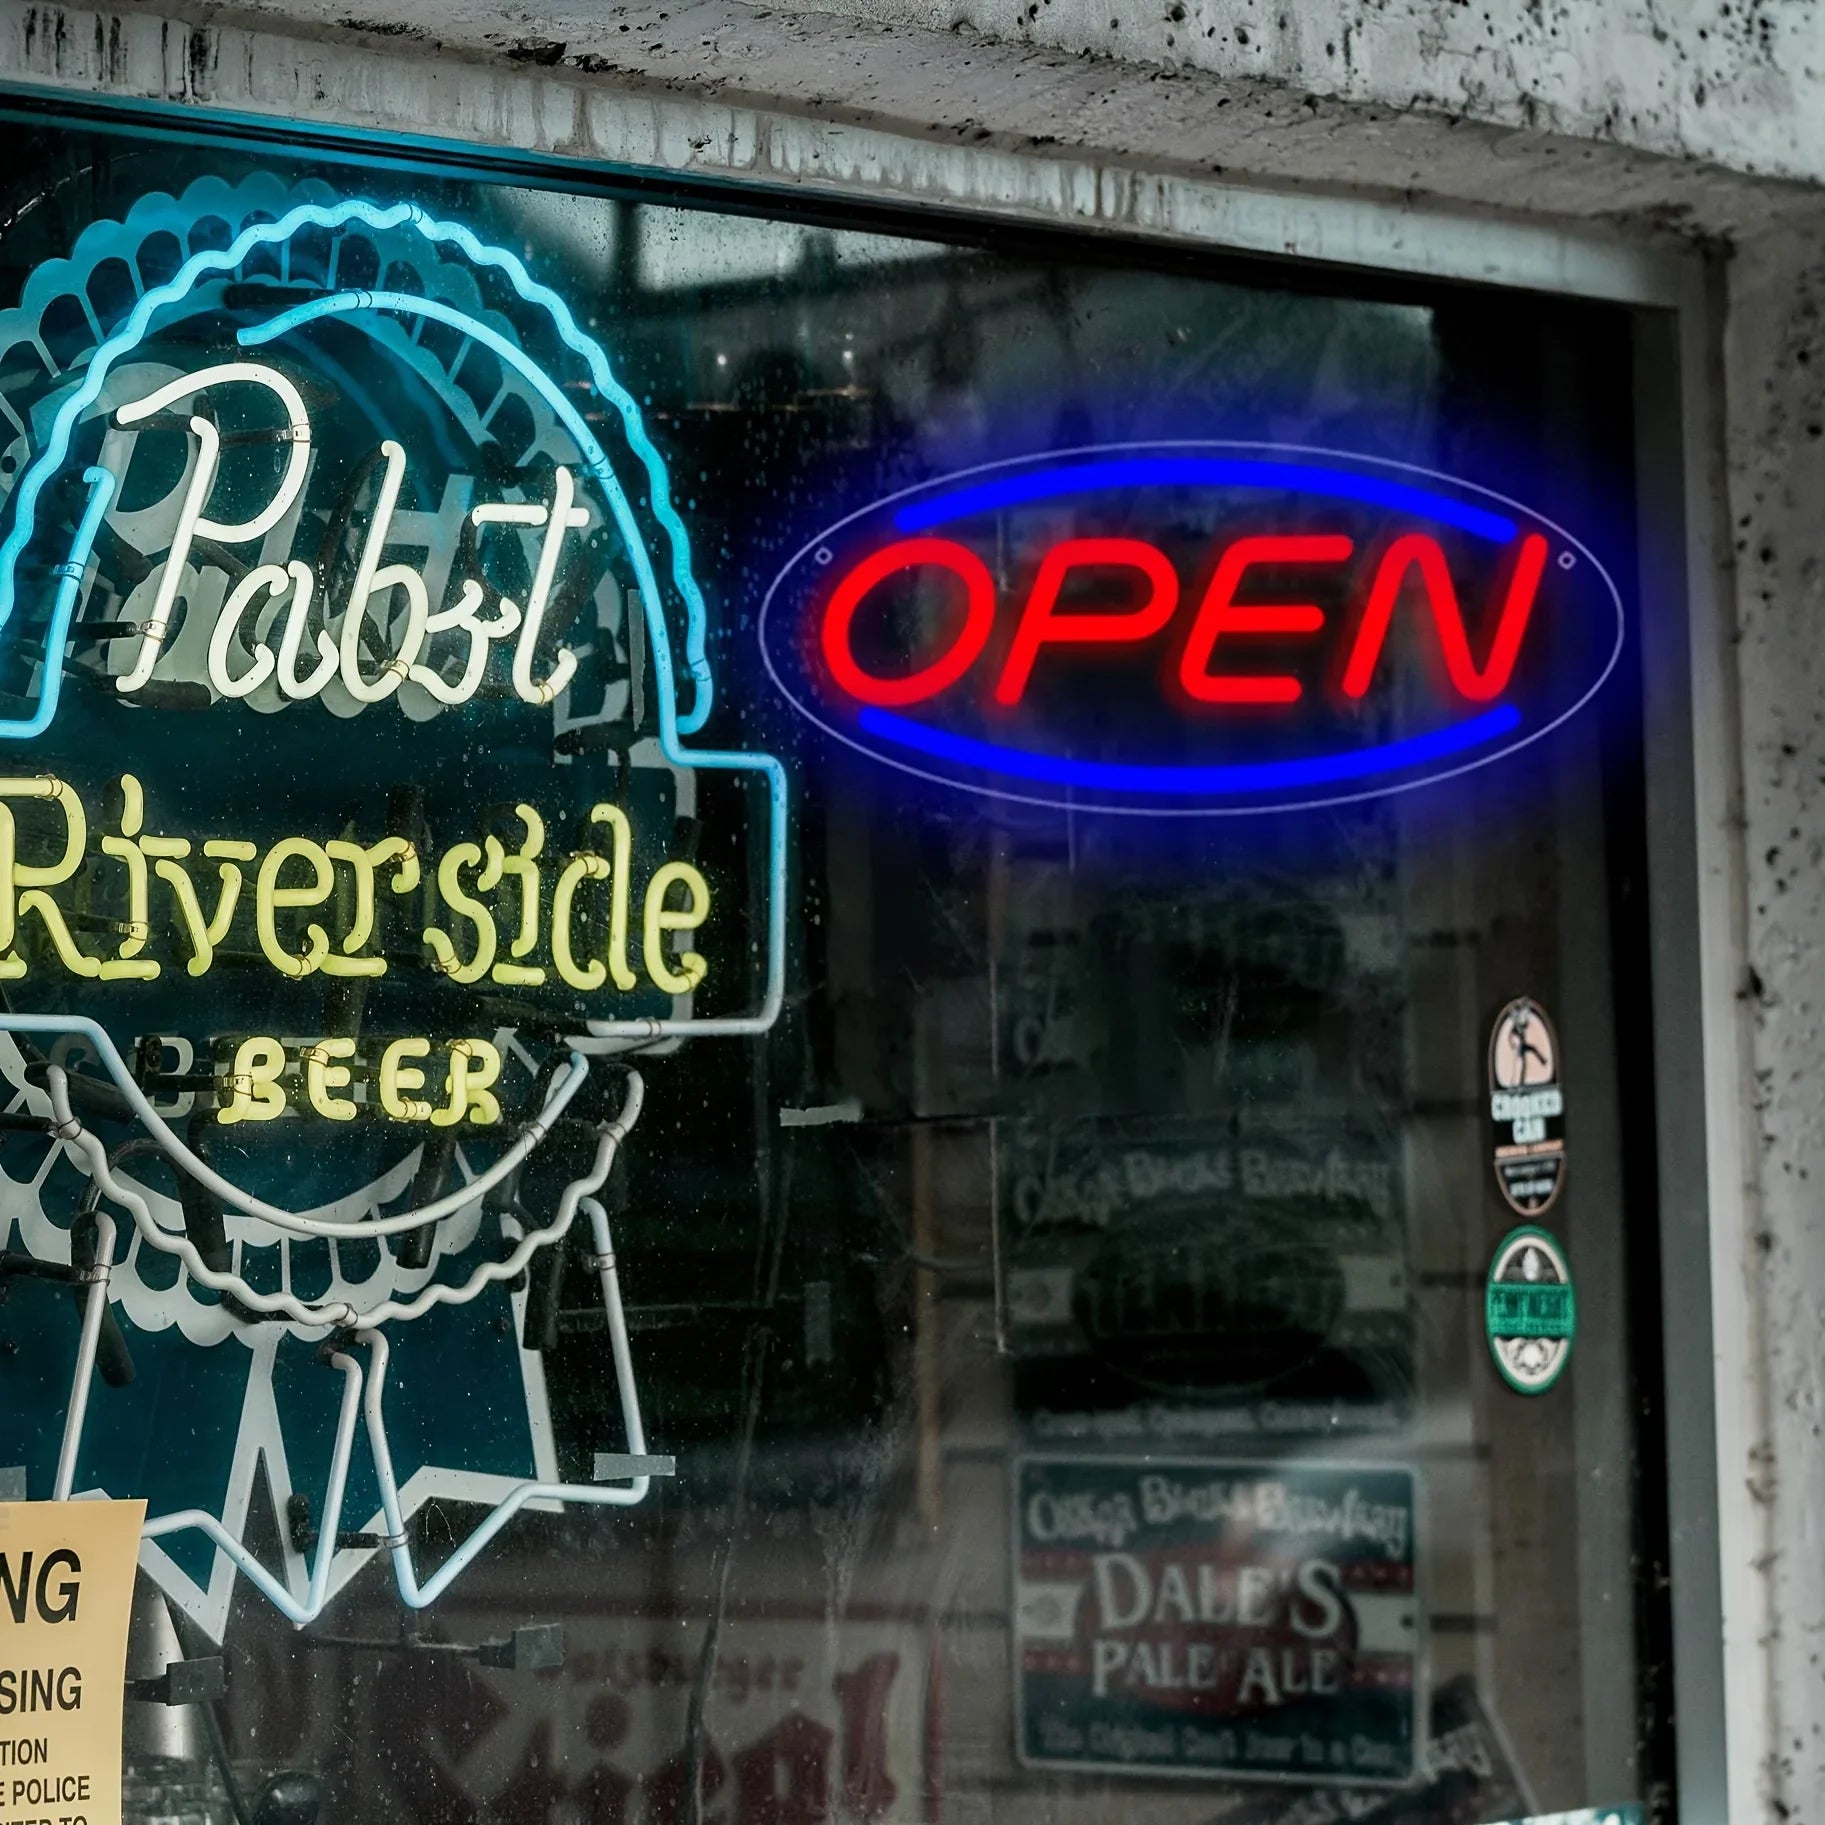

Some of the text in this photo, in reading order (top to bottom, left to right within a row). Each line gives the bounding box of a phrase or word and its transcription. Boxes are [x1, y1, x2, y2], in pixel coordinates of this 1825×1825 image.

[116, 363, 588, 705] Pabst
[821, 532, 1548, 706] OPEN
[0, 774, 711, 993] Riverside
[217, 1036, 501, 1126] BEER
[1093, 1639, 1340, 1706] PALE ALE
[13, 1775, 91, 1806] POLICE
